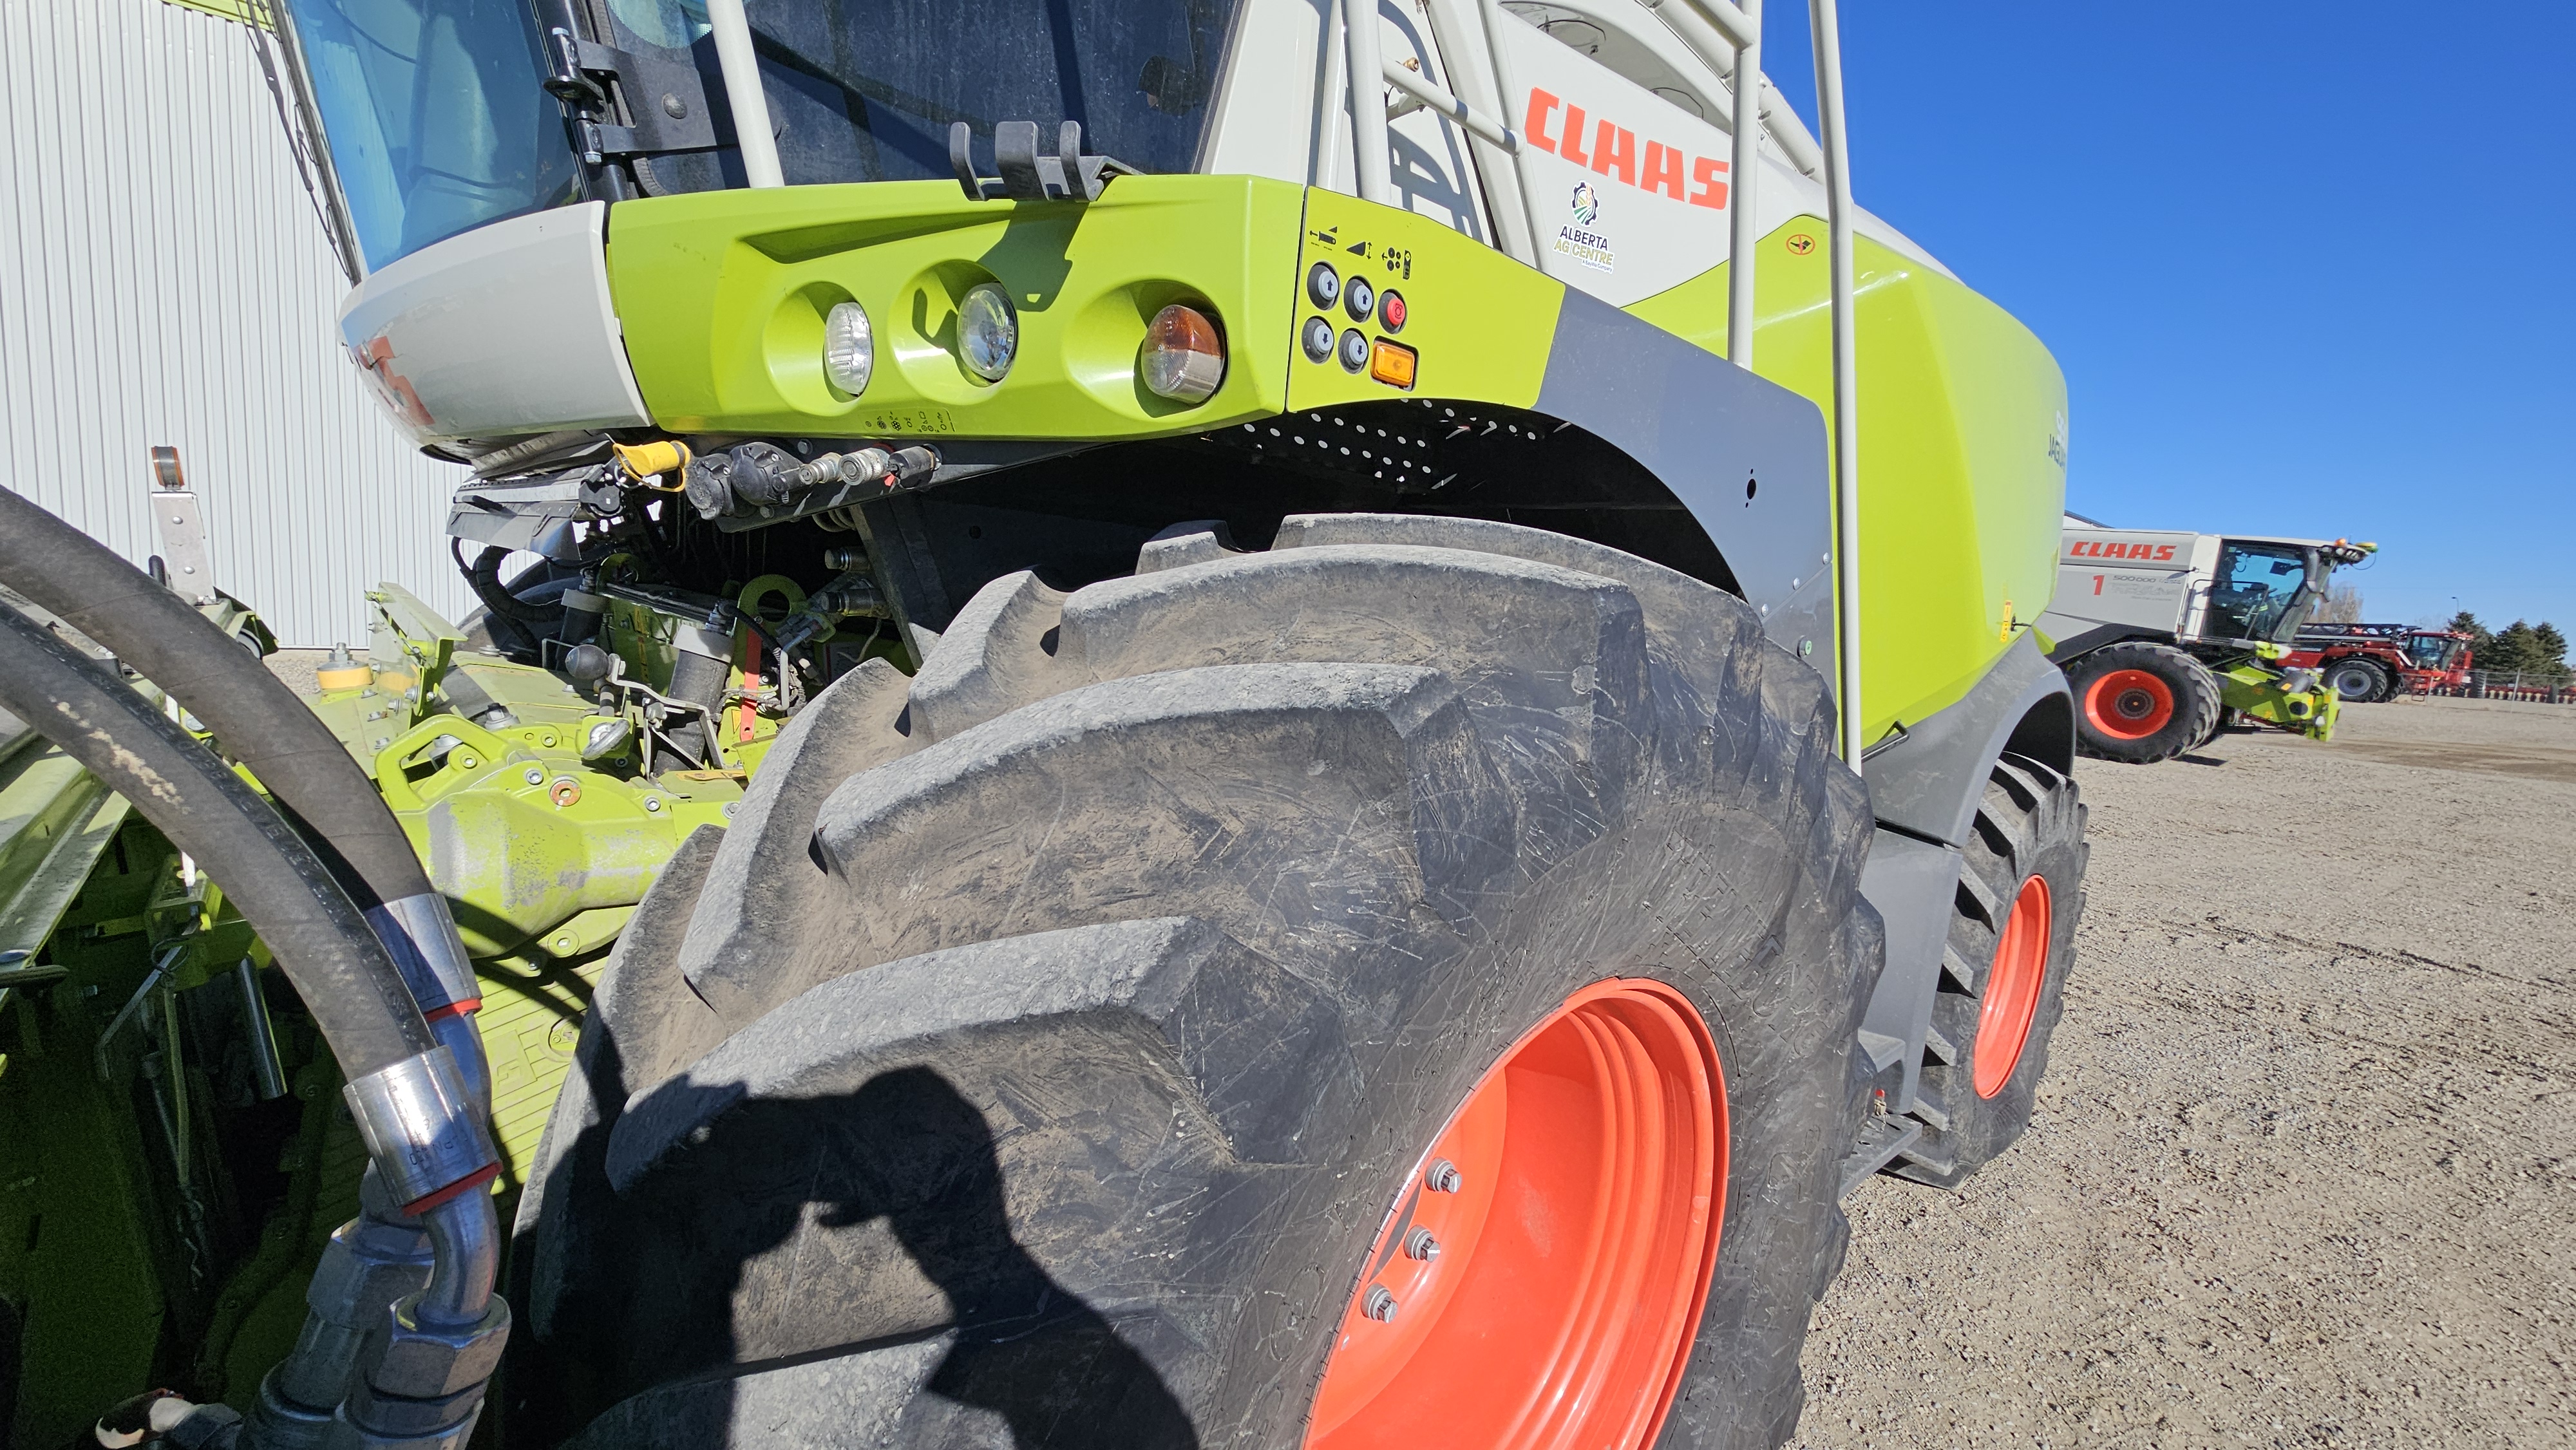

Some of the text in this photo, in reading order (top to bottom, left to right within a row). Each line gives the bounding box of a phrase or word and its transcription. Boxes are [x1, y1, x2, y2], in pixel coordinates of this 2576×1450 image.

[1524, 87, 1729, 210] CLAAS
[1560, 225, 1607, 250] ALBERTA
[1554, 239, 1613, 265] AG CENTRE
[2070, 541, 2176, 561] CLAAS
[2093, 575, 2105, 596] 1
